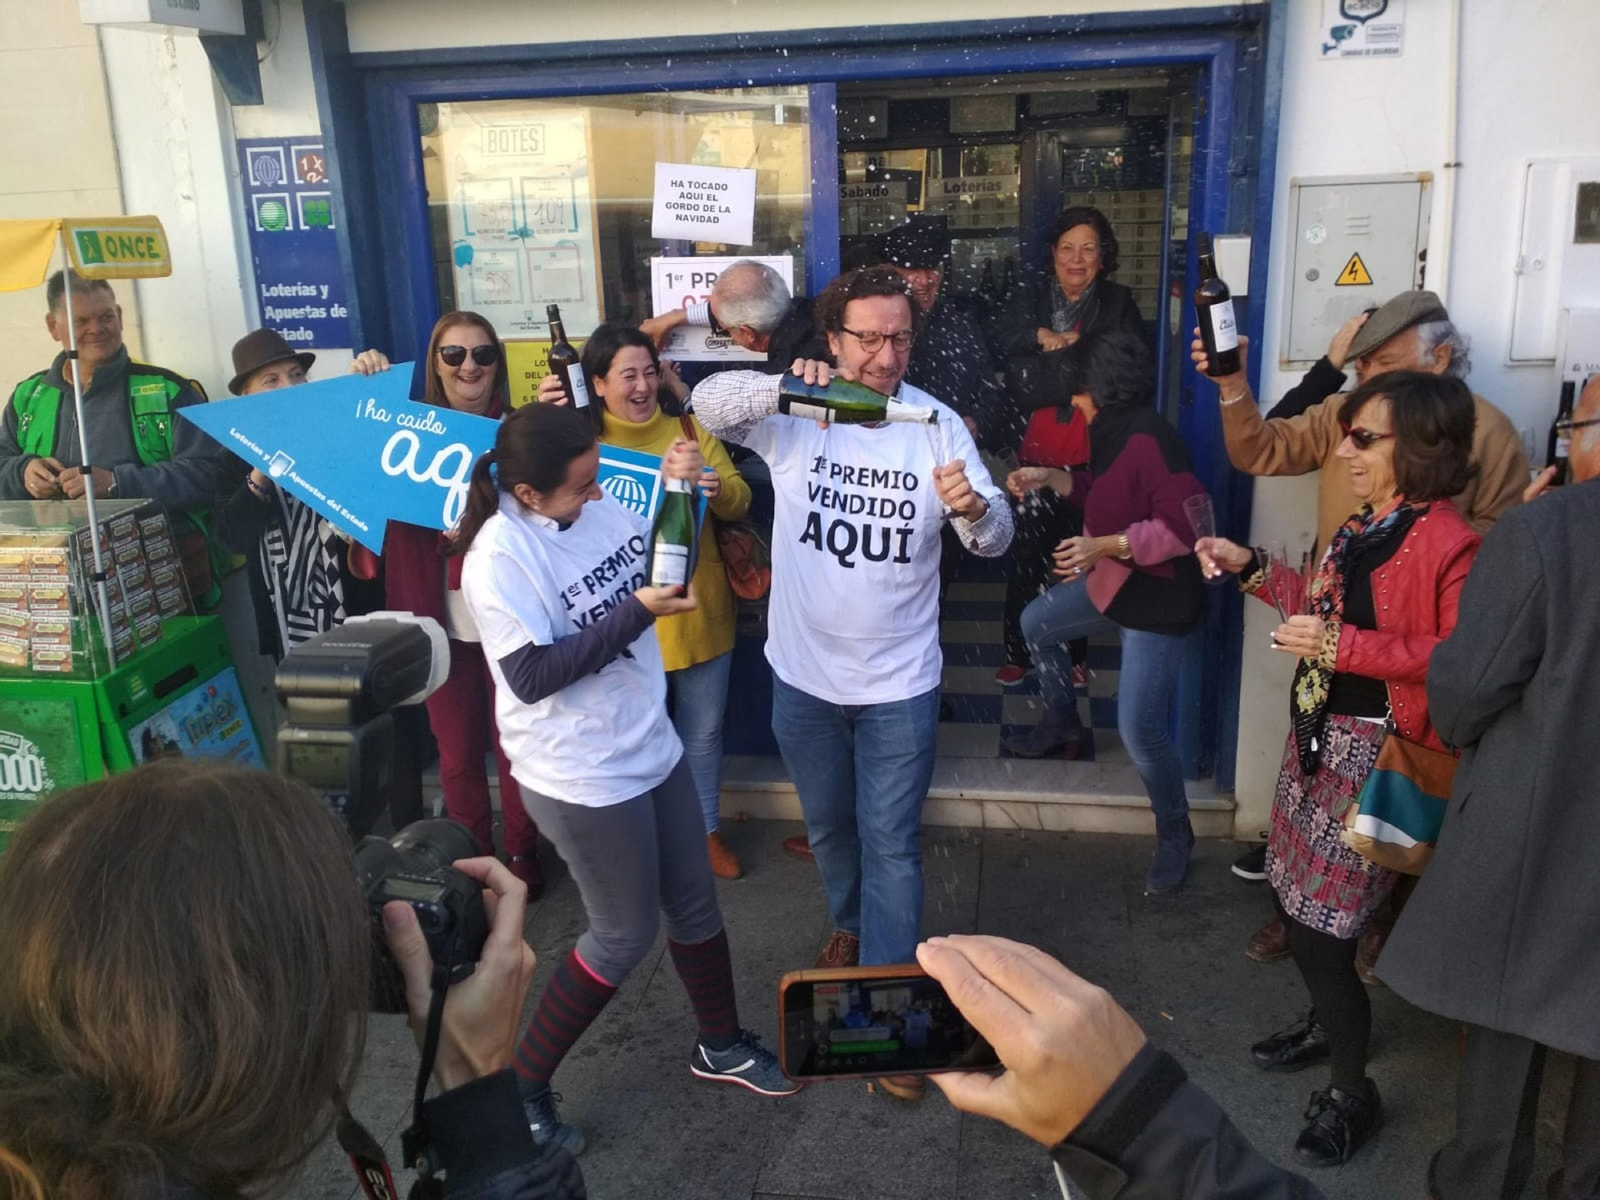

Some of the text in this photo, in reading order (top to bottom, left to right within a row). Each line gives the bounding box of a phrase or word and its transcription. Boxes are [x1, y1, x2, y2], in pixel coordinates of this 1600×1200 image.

[488, 128, 539, 153] BOTES
[671, 180, 728, 191] HA TOCADO
[665, 202, 731, 214] GORDO DE LA
[679, 192, 719, 202] AQUI EL
[676, 214, 720, 224] NAVIDAD
[105, 235, 160, 259] ONCE
[261, 281, 329, 300] Loterías y
[665, 273, 717, 289] 1er PR
[264, 303, 348, 323] Apuestas de
[272, 326, 314, 341] stado
[525, 371, 541, 379] DEL
[381, 429, 474, 530] aq
[829, 462, 919, 492] PREMIO
[288, 471, 369, 532] Apuestas del Estado
[807, 480, 916, 521] VENDIDO
[798, 510, 915, 569] AQUÍ
[560, 581, 582, 611] 1er
[582, 534, 646, 596] PREMIO
[572, 572, 646, 631] VENDID
